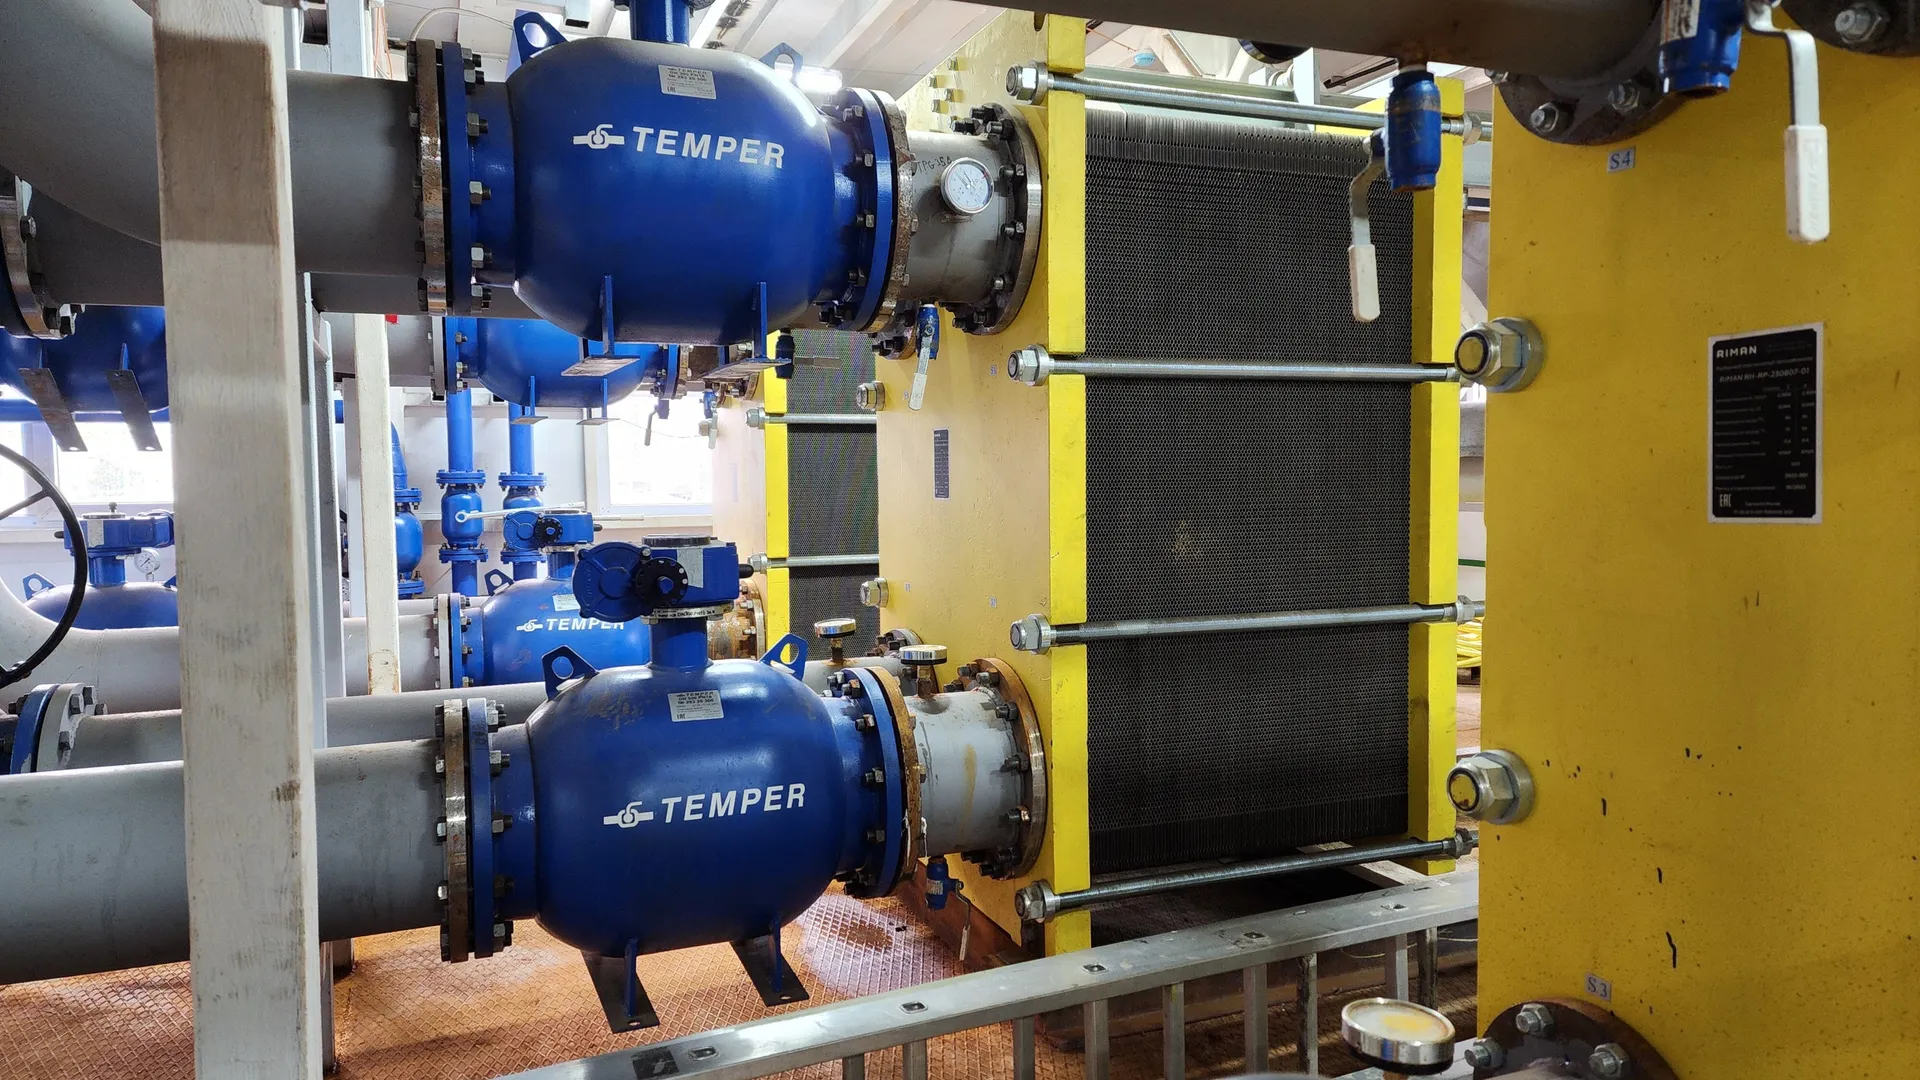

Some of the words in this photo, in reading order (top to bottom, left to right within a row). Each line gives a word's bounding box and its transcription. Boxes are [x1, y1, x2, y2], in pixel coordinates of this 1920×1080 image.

[632, 126, 785, 169] TEMPER
[1610, 150, 1630, 169] S4
[1716, 345, 1757, 359] RIMAN
[546, 618, 625, 631] TEMPER
[661, 782, 806, 823] TEMPER
[1588, 976, 1607, 998] S3
